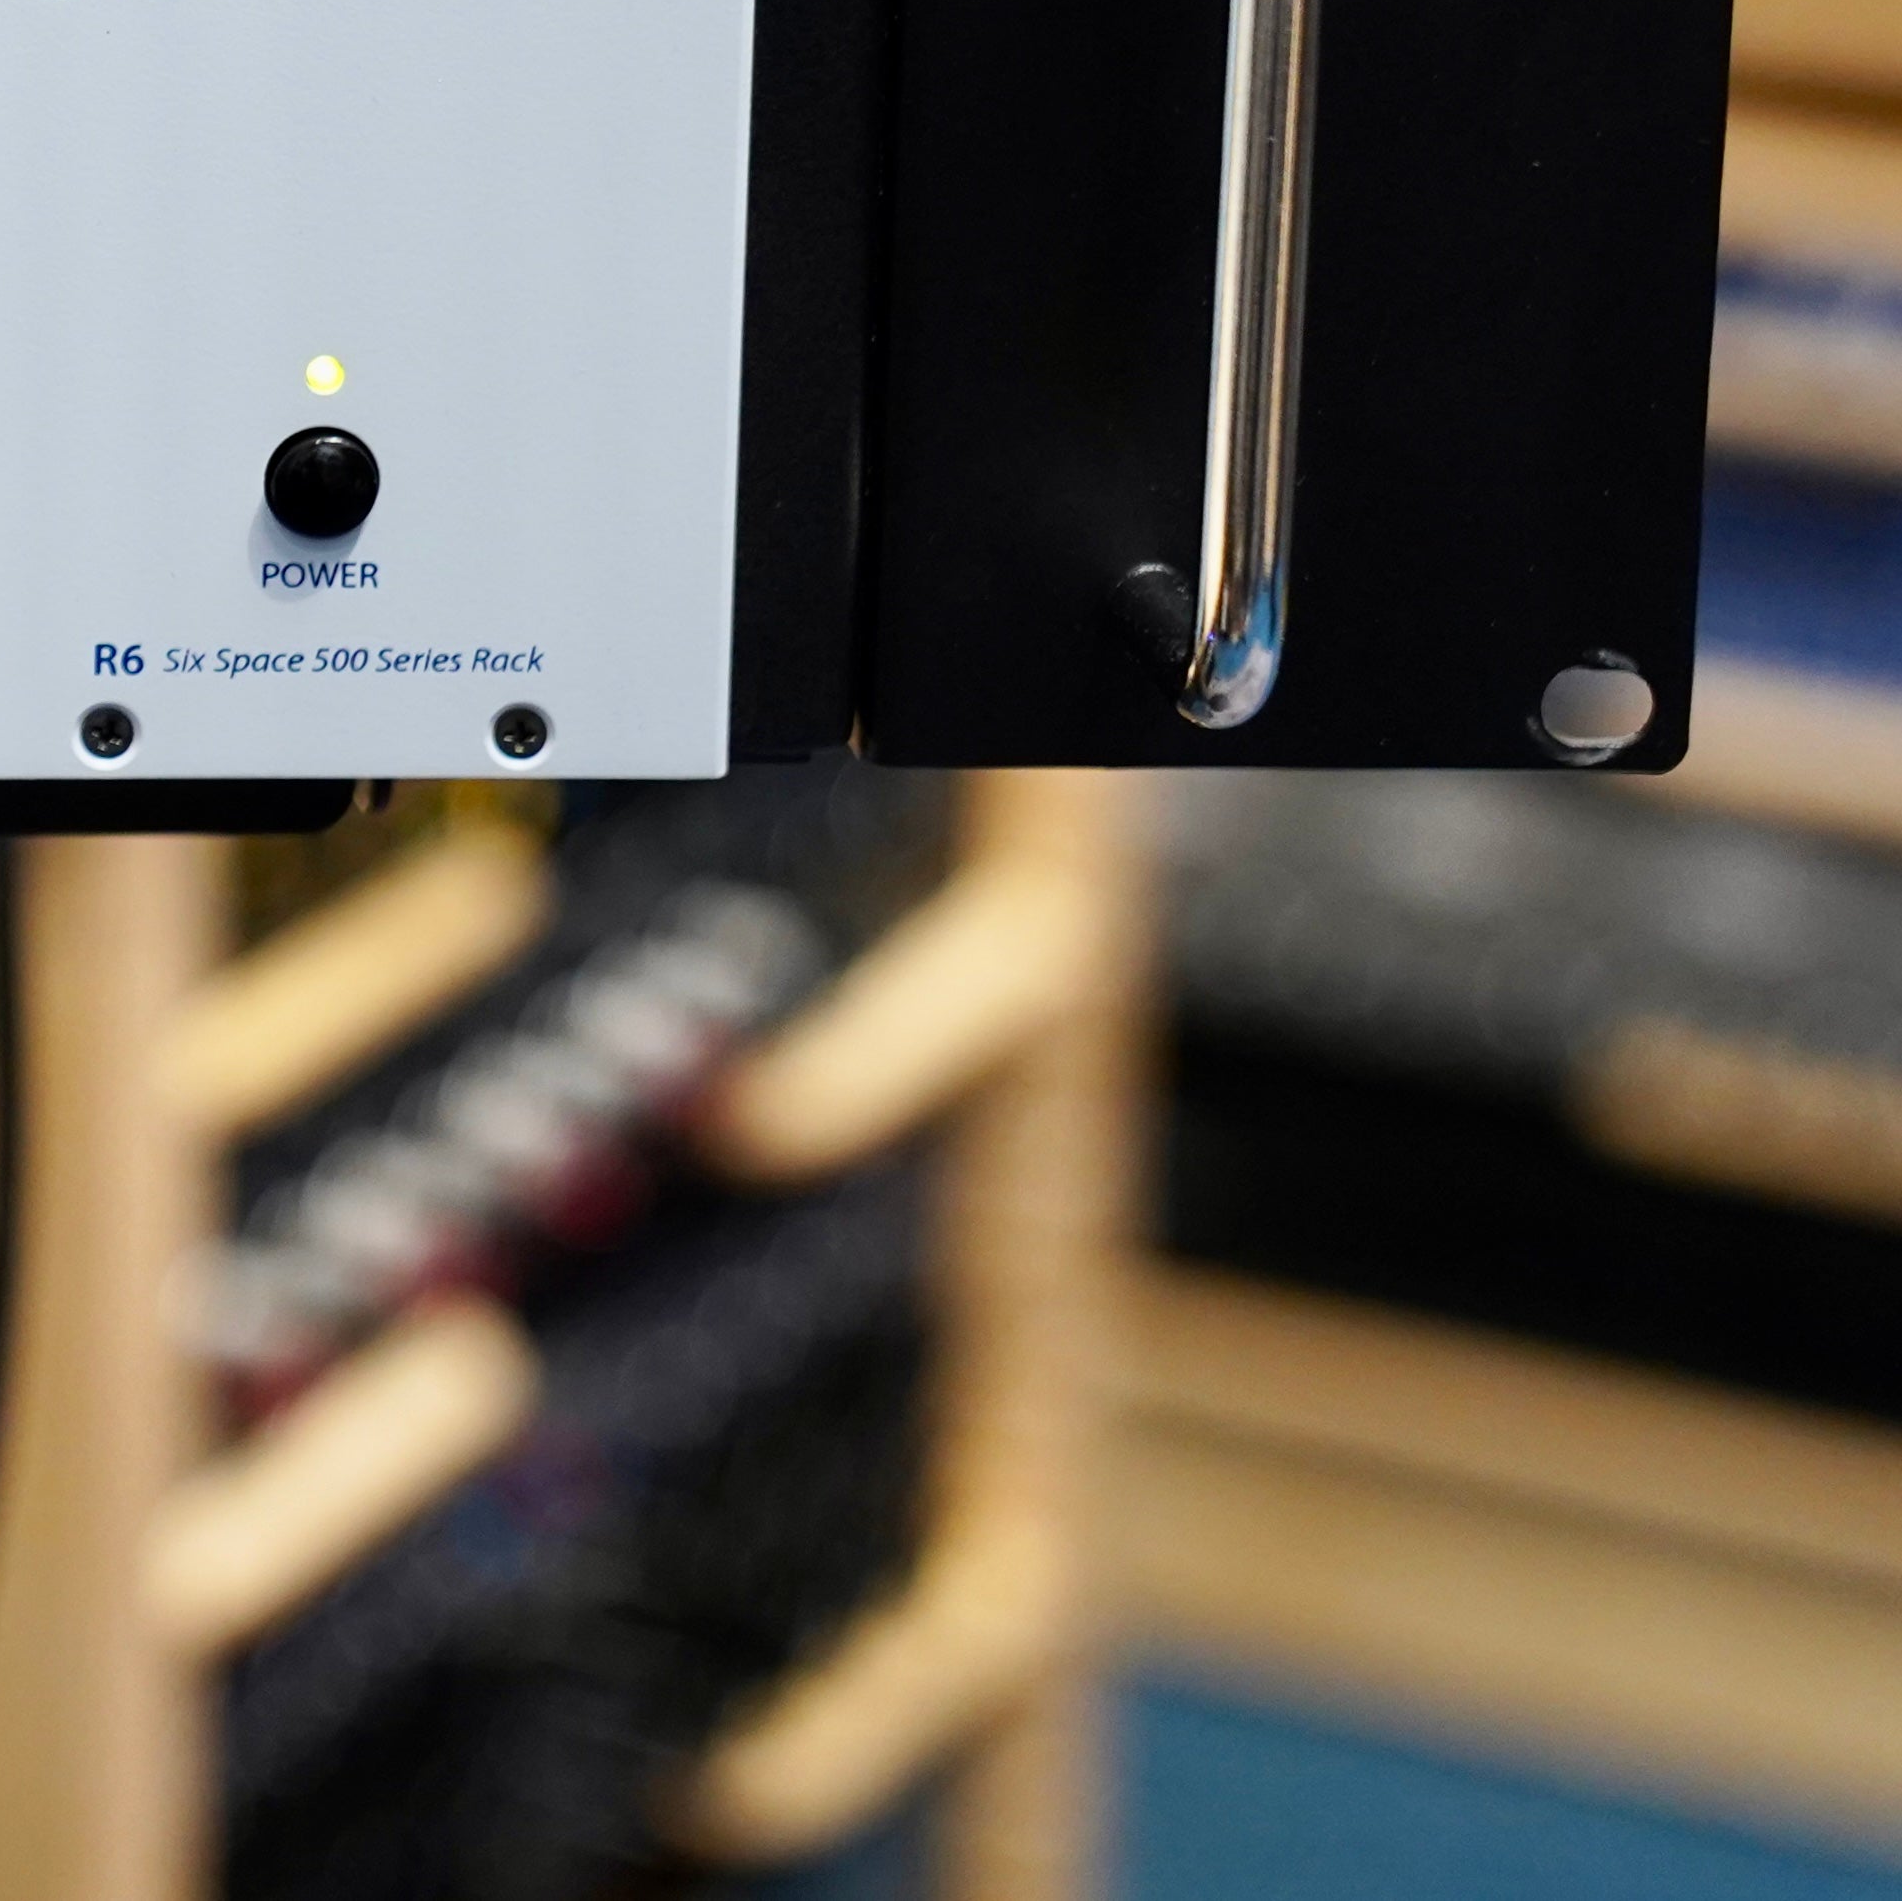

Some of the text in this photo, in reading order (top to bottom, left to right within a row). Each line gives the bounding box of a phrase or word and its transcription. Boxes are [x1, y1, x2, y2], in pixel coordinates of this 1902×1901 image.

[261, 560, 379, 589] POWER
[93, 642, 545, 680] R6 Six Space 500 Series Rack
